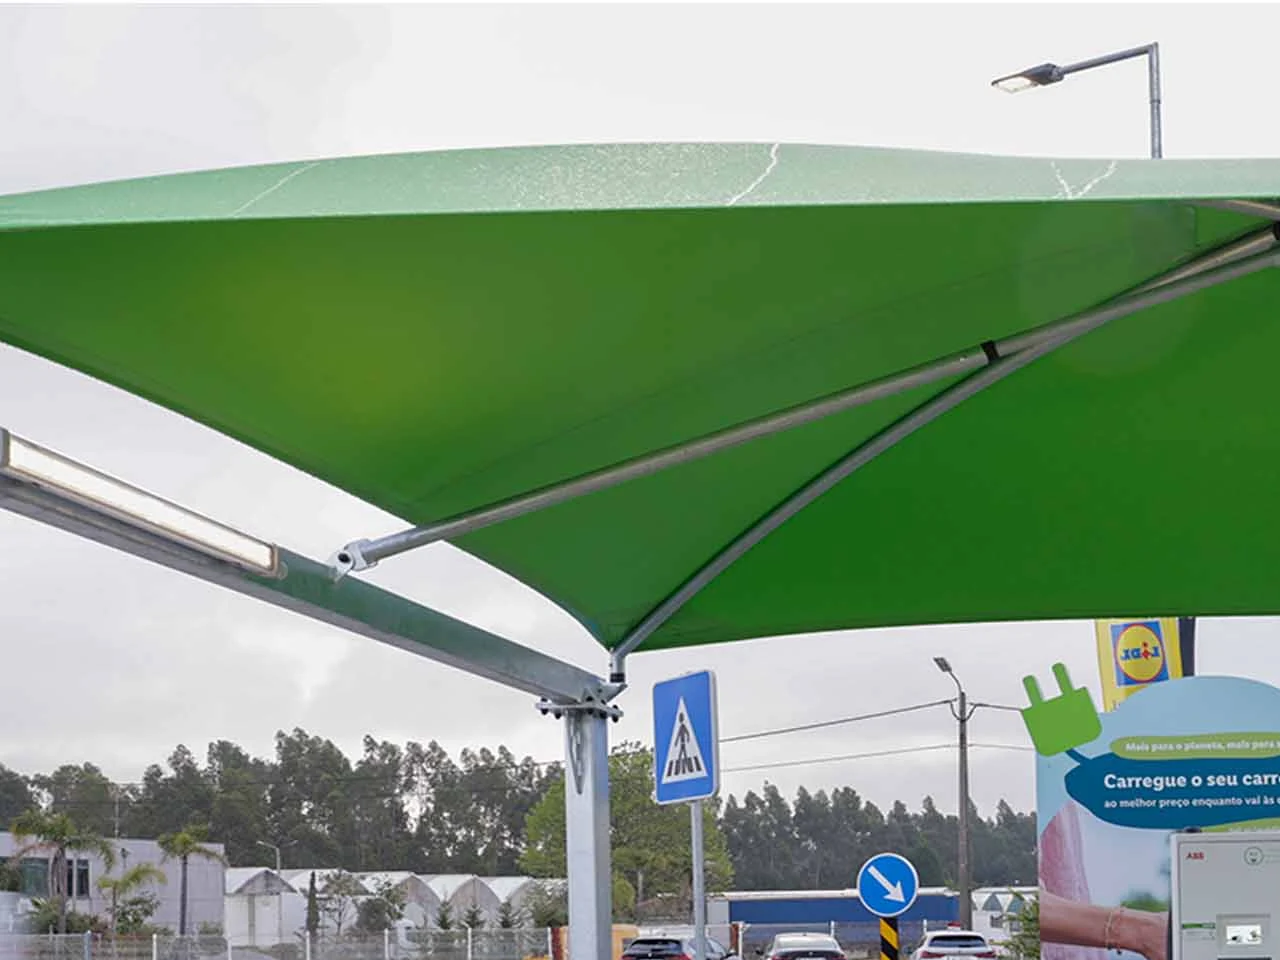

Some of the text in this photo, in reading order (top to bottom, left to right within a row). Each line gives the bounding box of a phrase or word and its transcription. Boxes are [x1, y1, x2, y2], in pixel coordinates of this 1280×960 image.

[1126, 742, 1149, 750] Mais
[1151, 743, 1174, 752] para
[1227, 740, 1250, 749] mais
[1251, 741, 1277, 751] para
[1103, 774, 1187, 791] Carregue
[1191, 775, 1203, 787] o
[1207, 774, 1238, 787] seu
[1104, 799, 1118, 809] ao
[1119, 798, 1157, 808] melhor
[1159, 798, 1190, 809] preço
[1191, 797, 1243, 808] enquanto
[1244, 795, 1261, 805] vai
[1263, 795, 1275, 805] às
[1185, 851, 1205, 860] ABB
